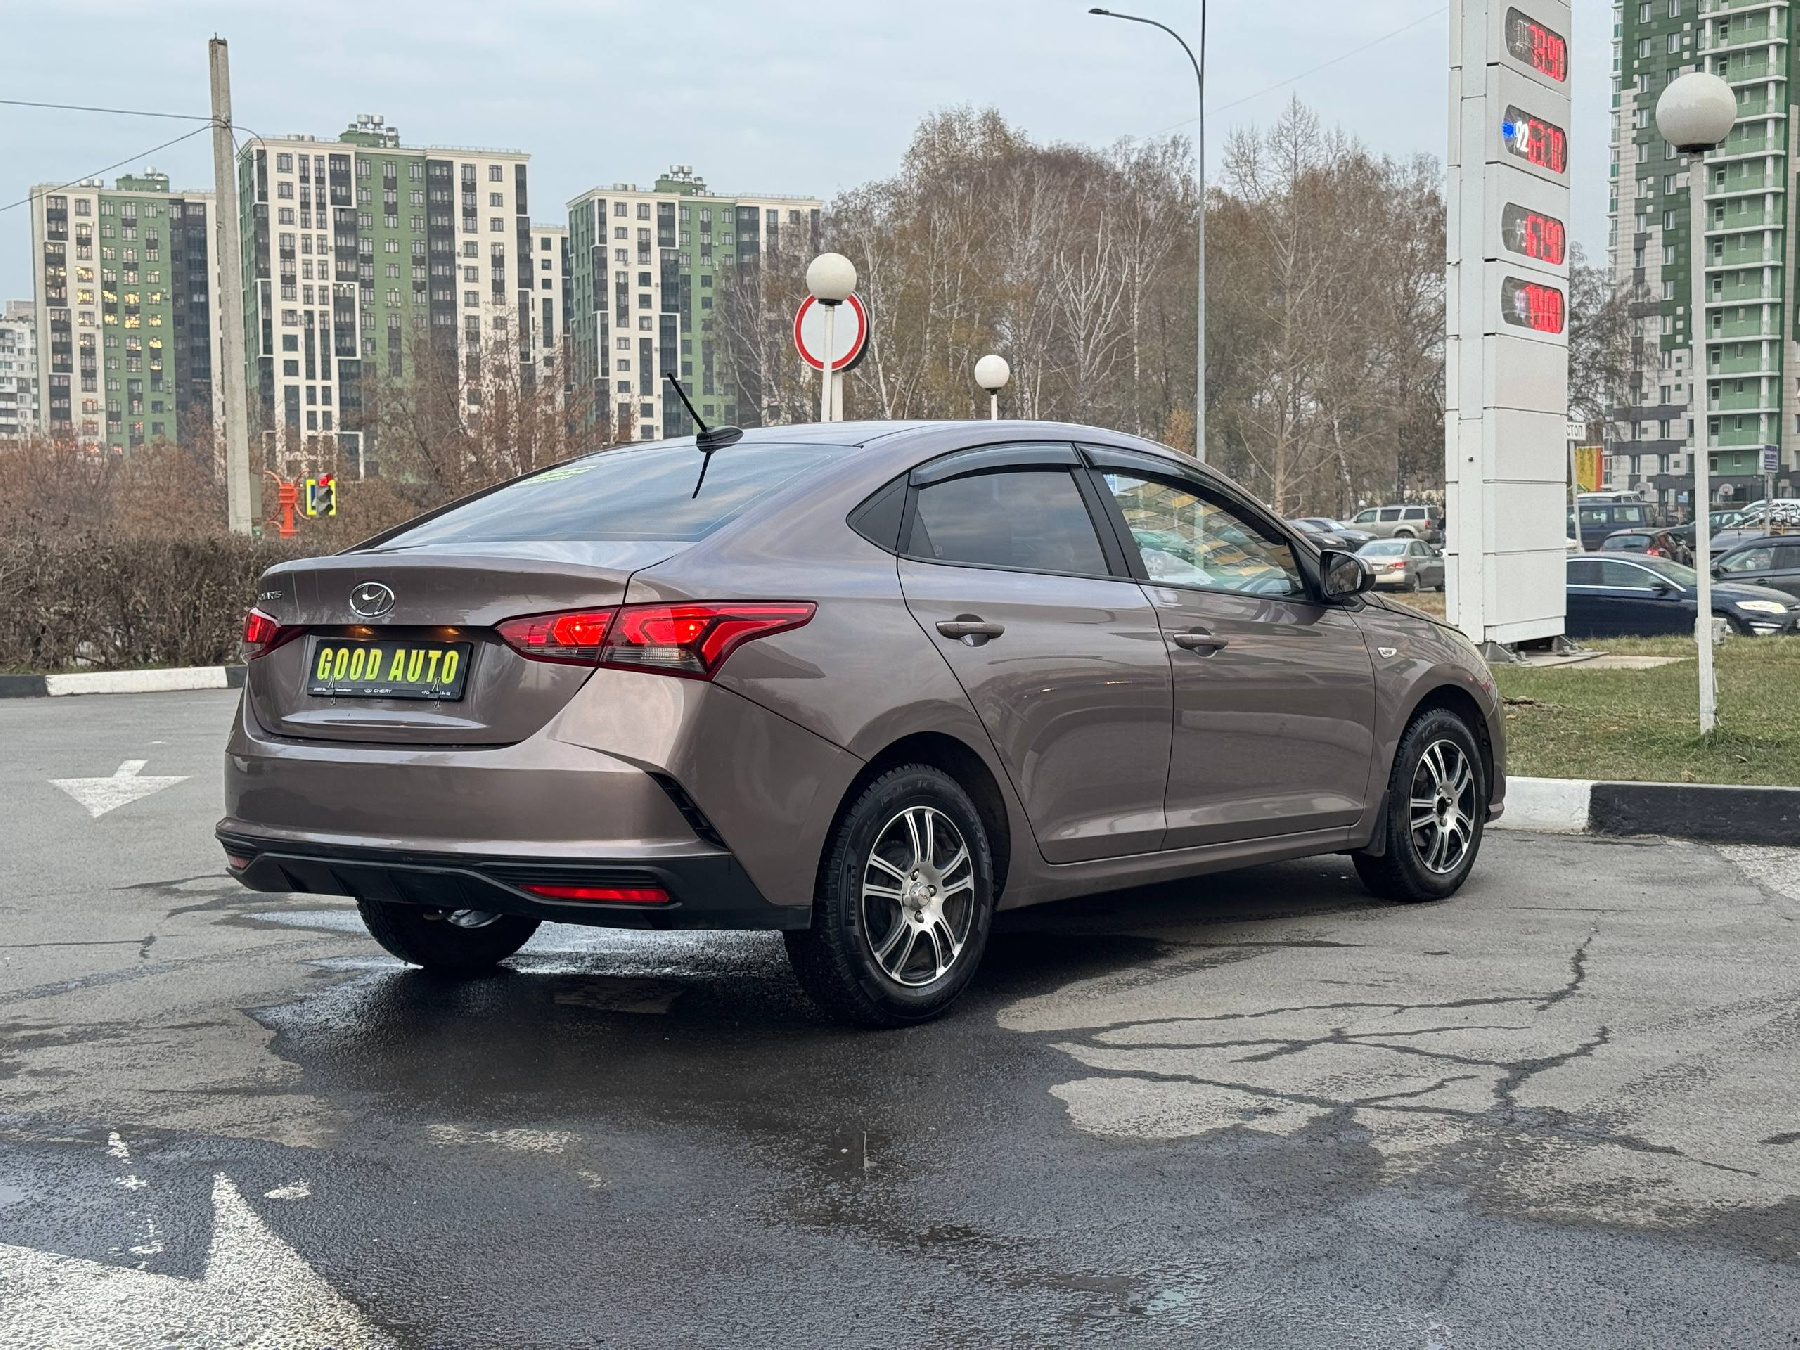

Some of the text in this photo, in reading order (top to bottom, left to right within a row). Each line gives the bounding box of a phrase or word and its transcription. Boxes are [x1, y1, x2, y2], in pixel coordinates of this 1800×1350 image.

[1514, 120, 1529, 152] 92
[317, 648, 459, 684] GOOD AUTO
